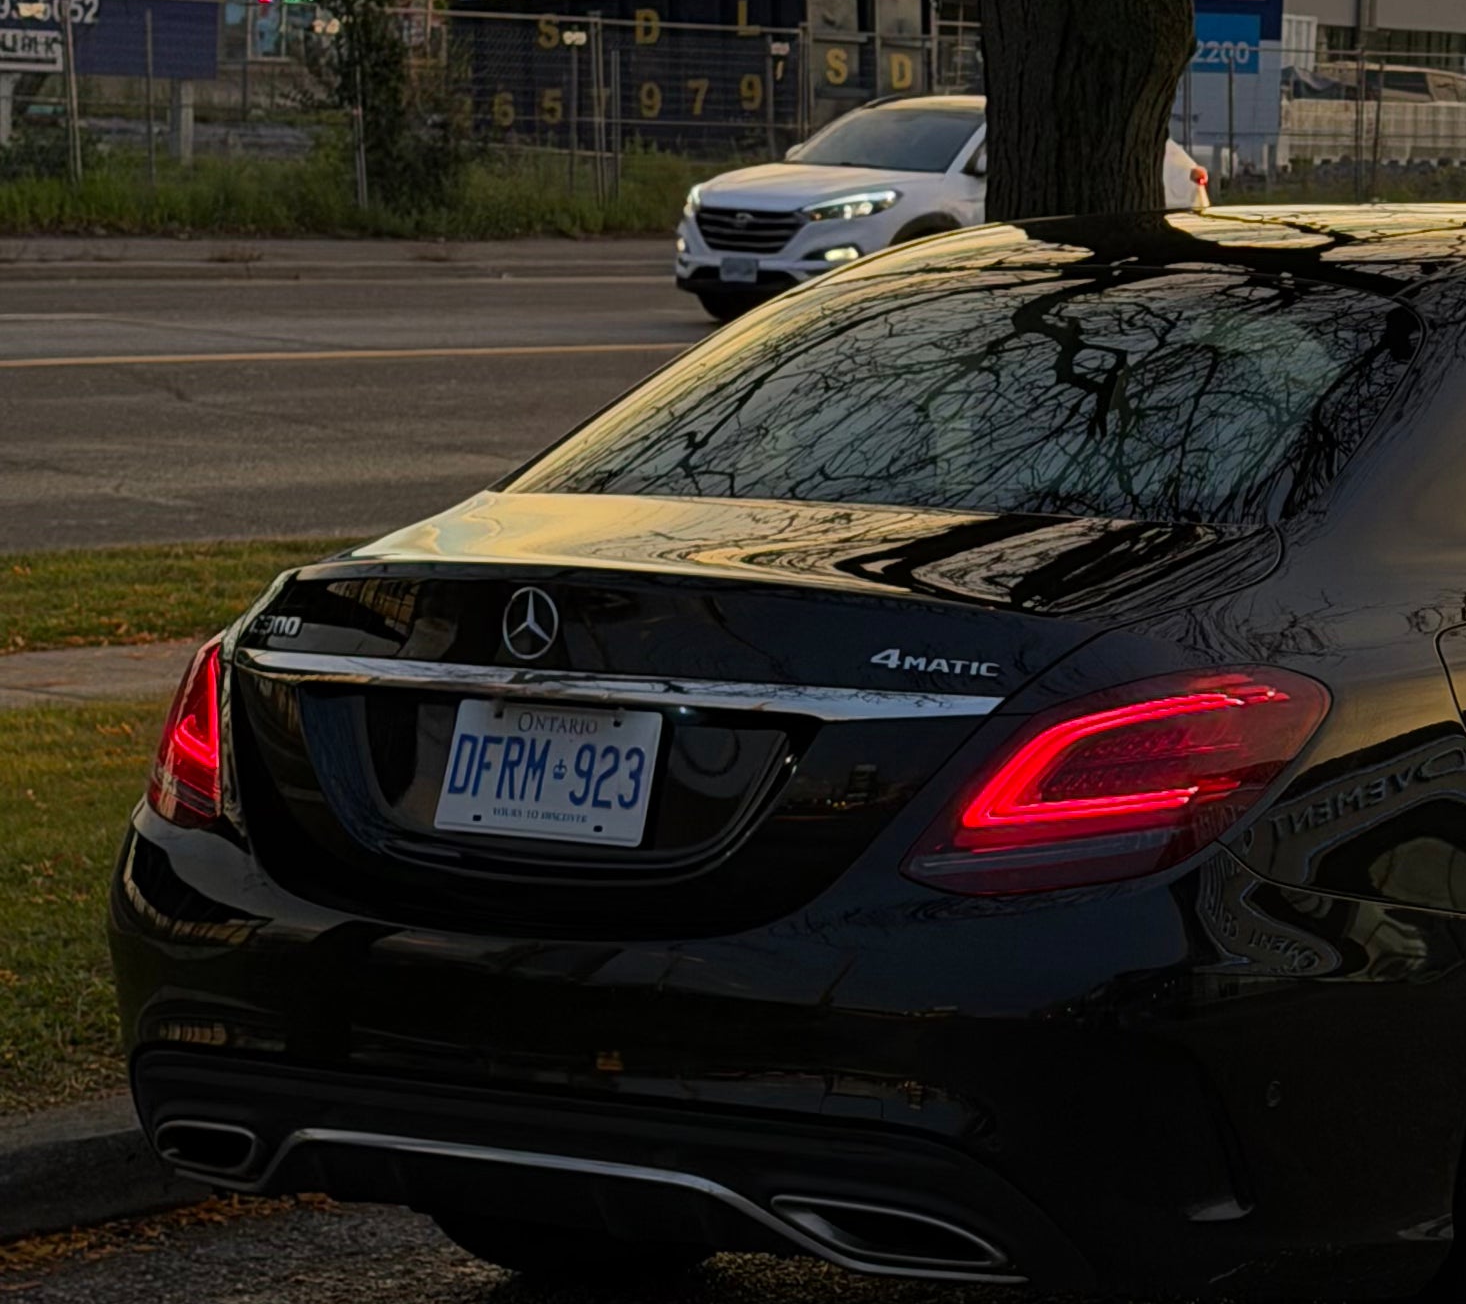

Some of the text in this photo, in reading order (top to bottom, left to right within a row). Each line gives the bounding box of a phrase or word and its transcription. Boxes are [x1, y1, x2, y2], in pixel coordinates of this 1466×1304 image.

[1193, 41, 1251, 64] 2200
[870, 648, 1001, 677] 4MATIC
[517, 711, 599, 735] ONTARIO
[447, 733, 647, 811] DFRM 923
[493, 806, 523, 818] YOURS
[526, 809, 539, 820] TO
